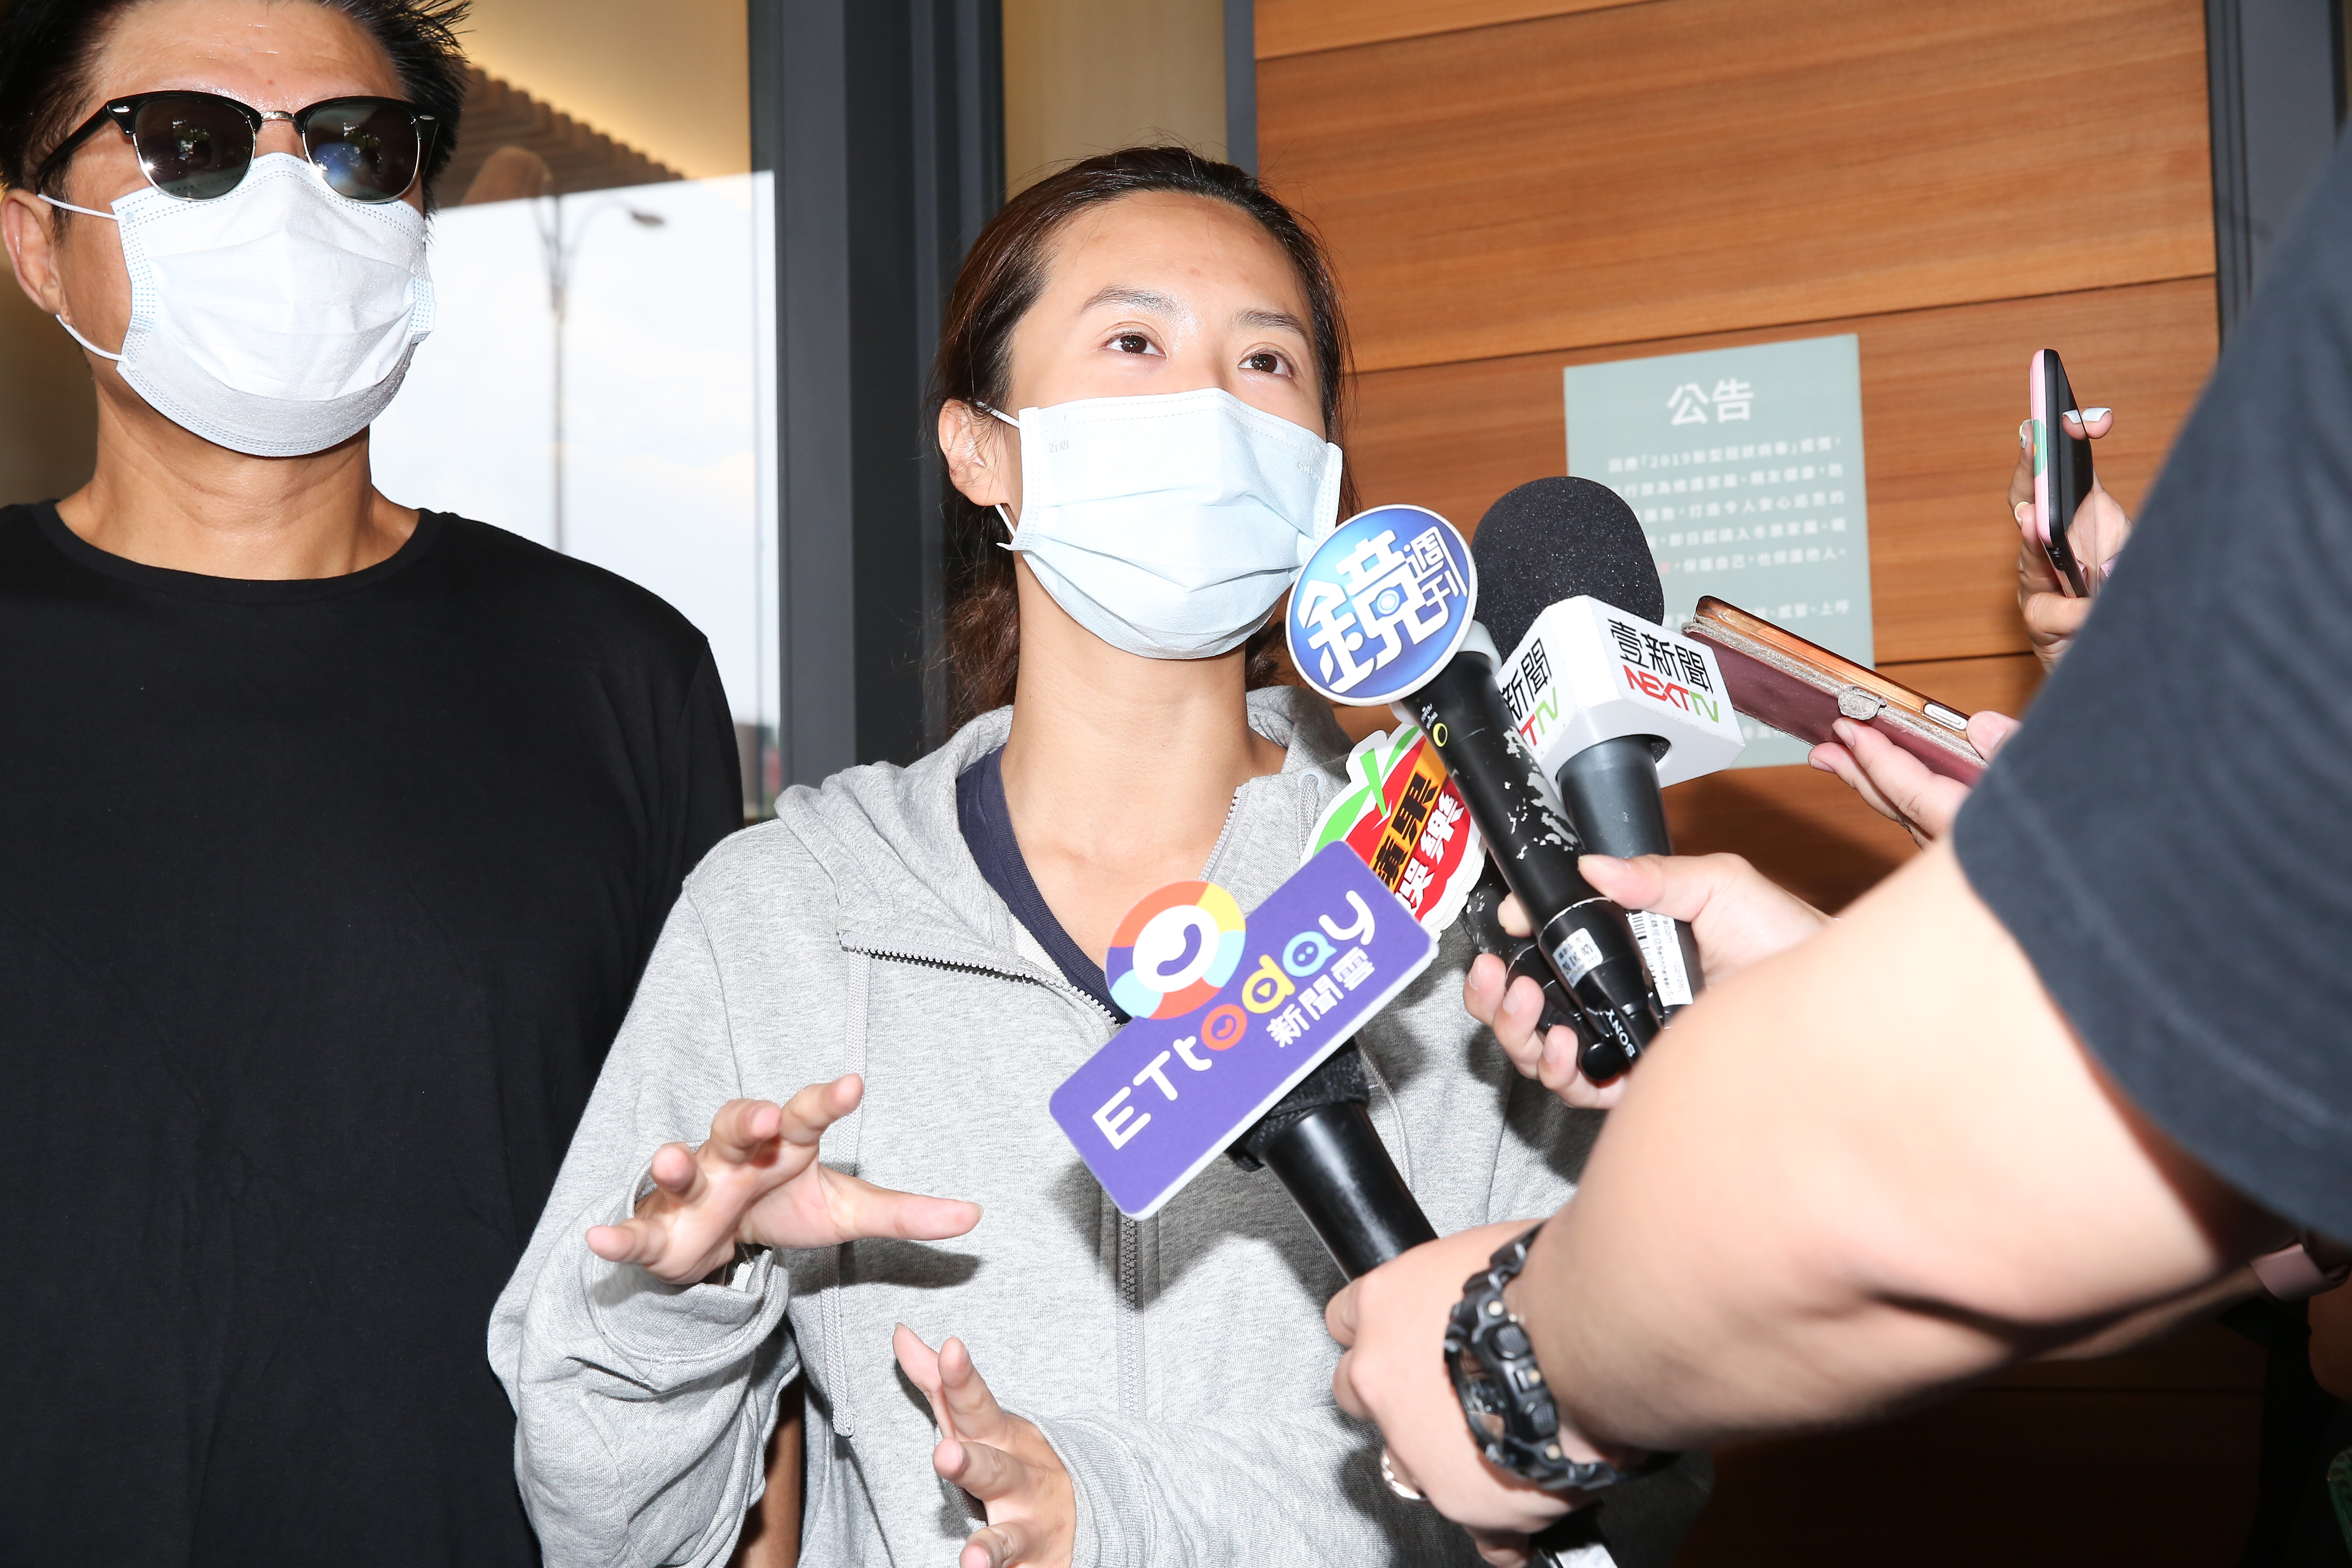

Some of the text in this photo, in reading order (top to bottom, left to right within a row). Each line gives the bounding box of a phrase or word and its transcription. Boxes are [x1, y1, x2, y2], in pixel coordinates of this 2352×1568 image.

[1666, 378, 1754, 425] 公告
[1500, 637, 1552, 721] 新聞
[1608, 618, 1714, 695] 壹新聞
[1092, 890, 1376, 1151] ETtoday
[1266, 946, 1375, 1048] 新聞雲
[1604, 1008, 1636, 1057] SONY
